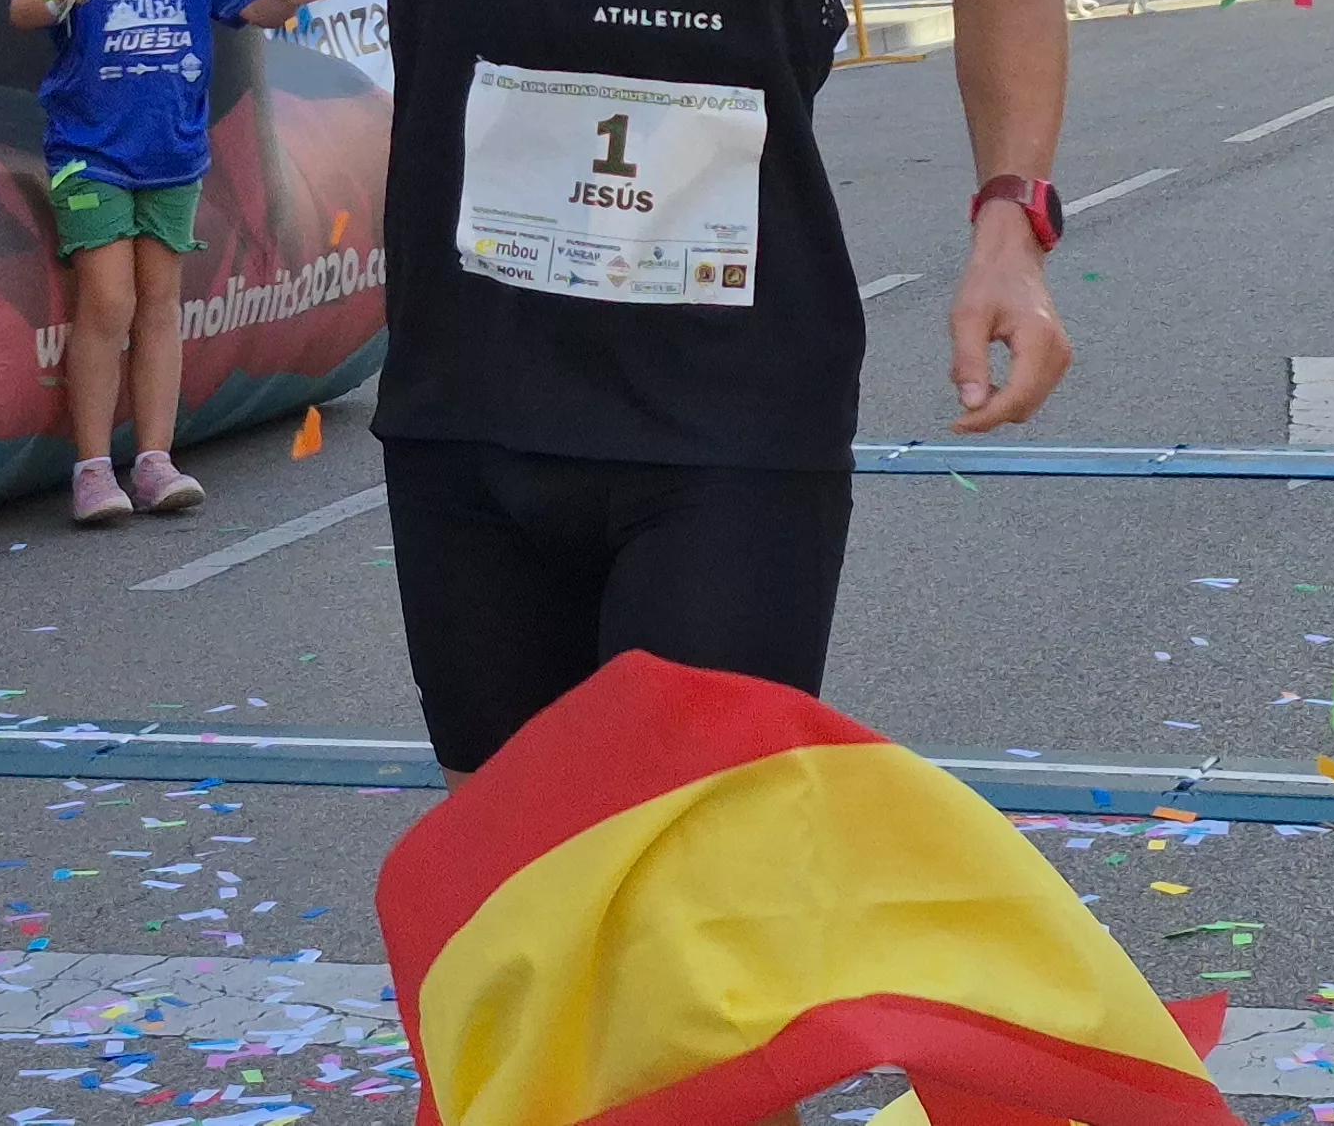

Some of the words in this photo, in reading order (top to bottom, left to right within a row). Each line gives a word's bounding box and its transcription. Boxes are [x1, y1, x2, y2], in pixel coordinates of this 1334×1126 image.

[593, 7, 723, 31] ATHLETICS
[592, 114, 637, 178] 1
[568, 182, 655, 213] JESÚS
